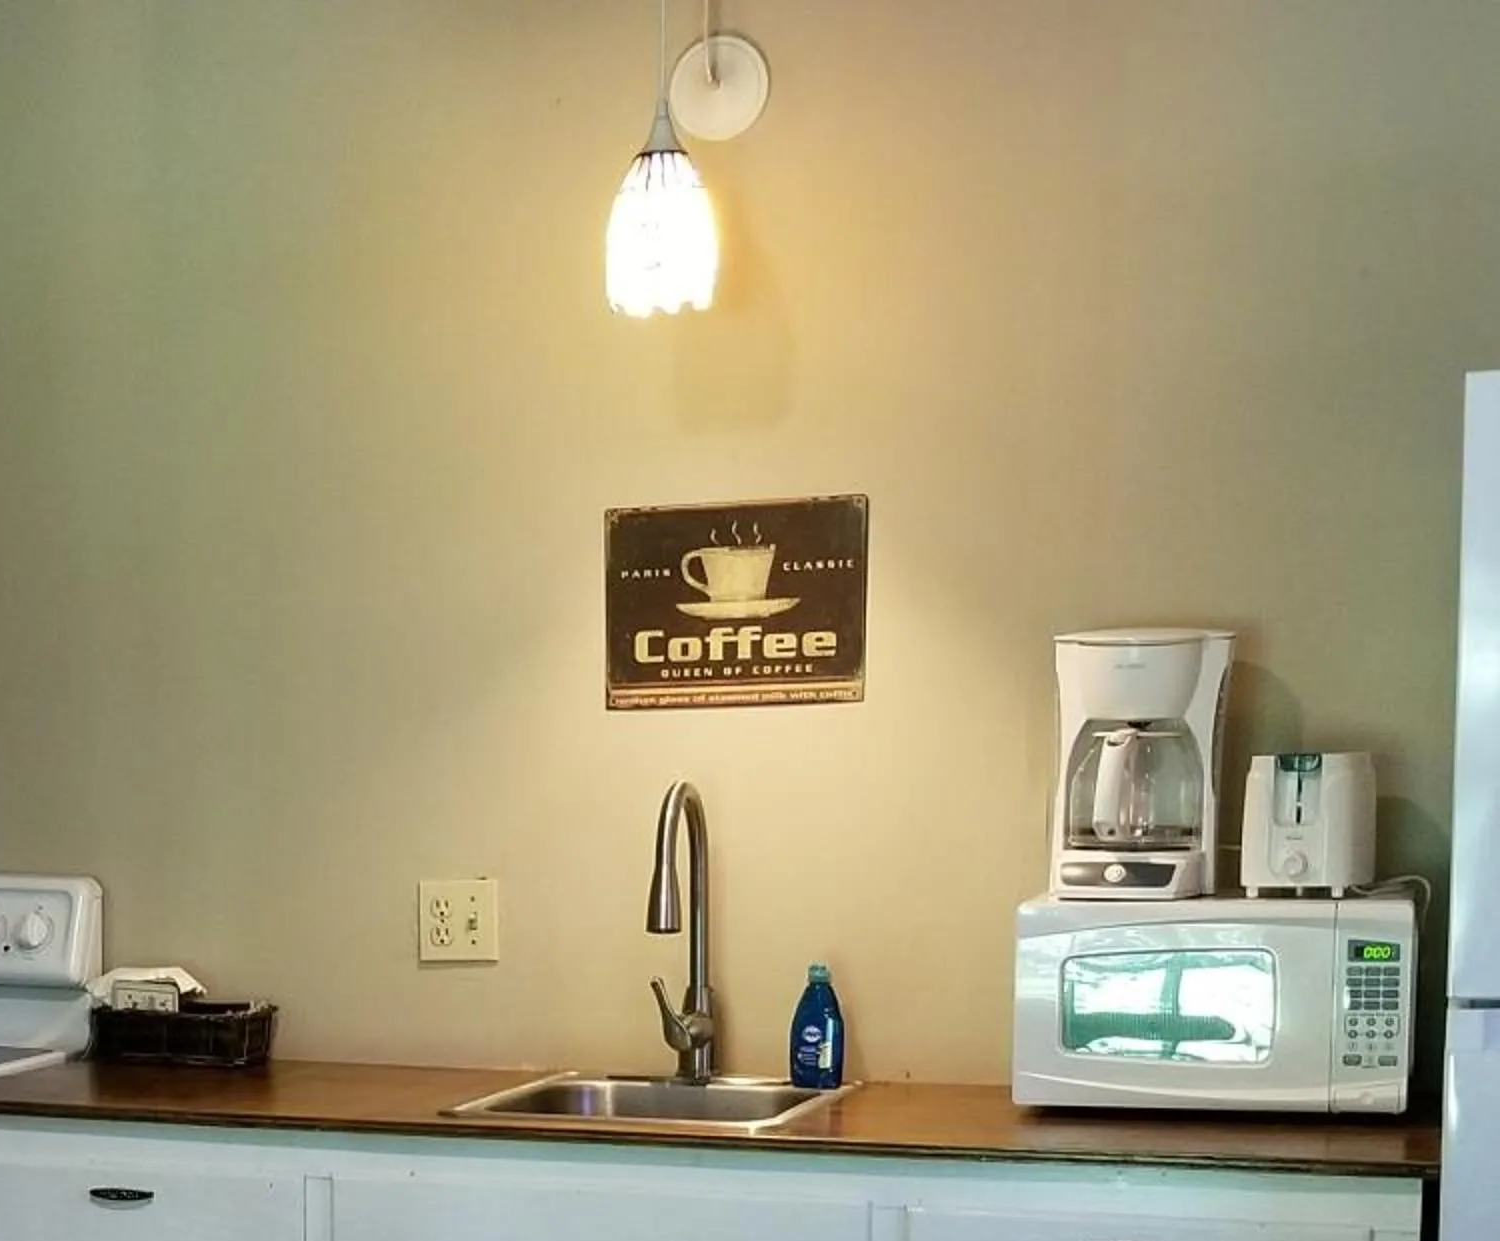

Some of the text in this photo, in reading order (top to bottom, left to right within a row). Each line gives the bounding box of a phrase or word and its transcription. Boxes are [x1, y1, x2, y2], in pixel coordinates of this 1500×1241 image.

[783, 559, 854, 571] CLASSIC
[621, 569, 671, 579] PARIS
[634, 625, 837, 664] Coffee
[661, 663, 813, 678] QUEEN OF COFFEE
